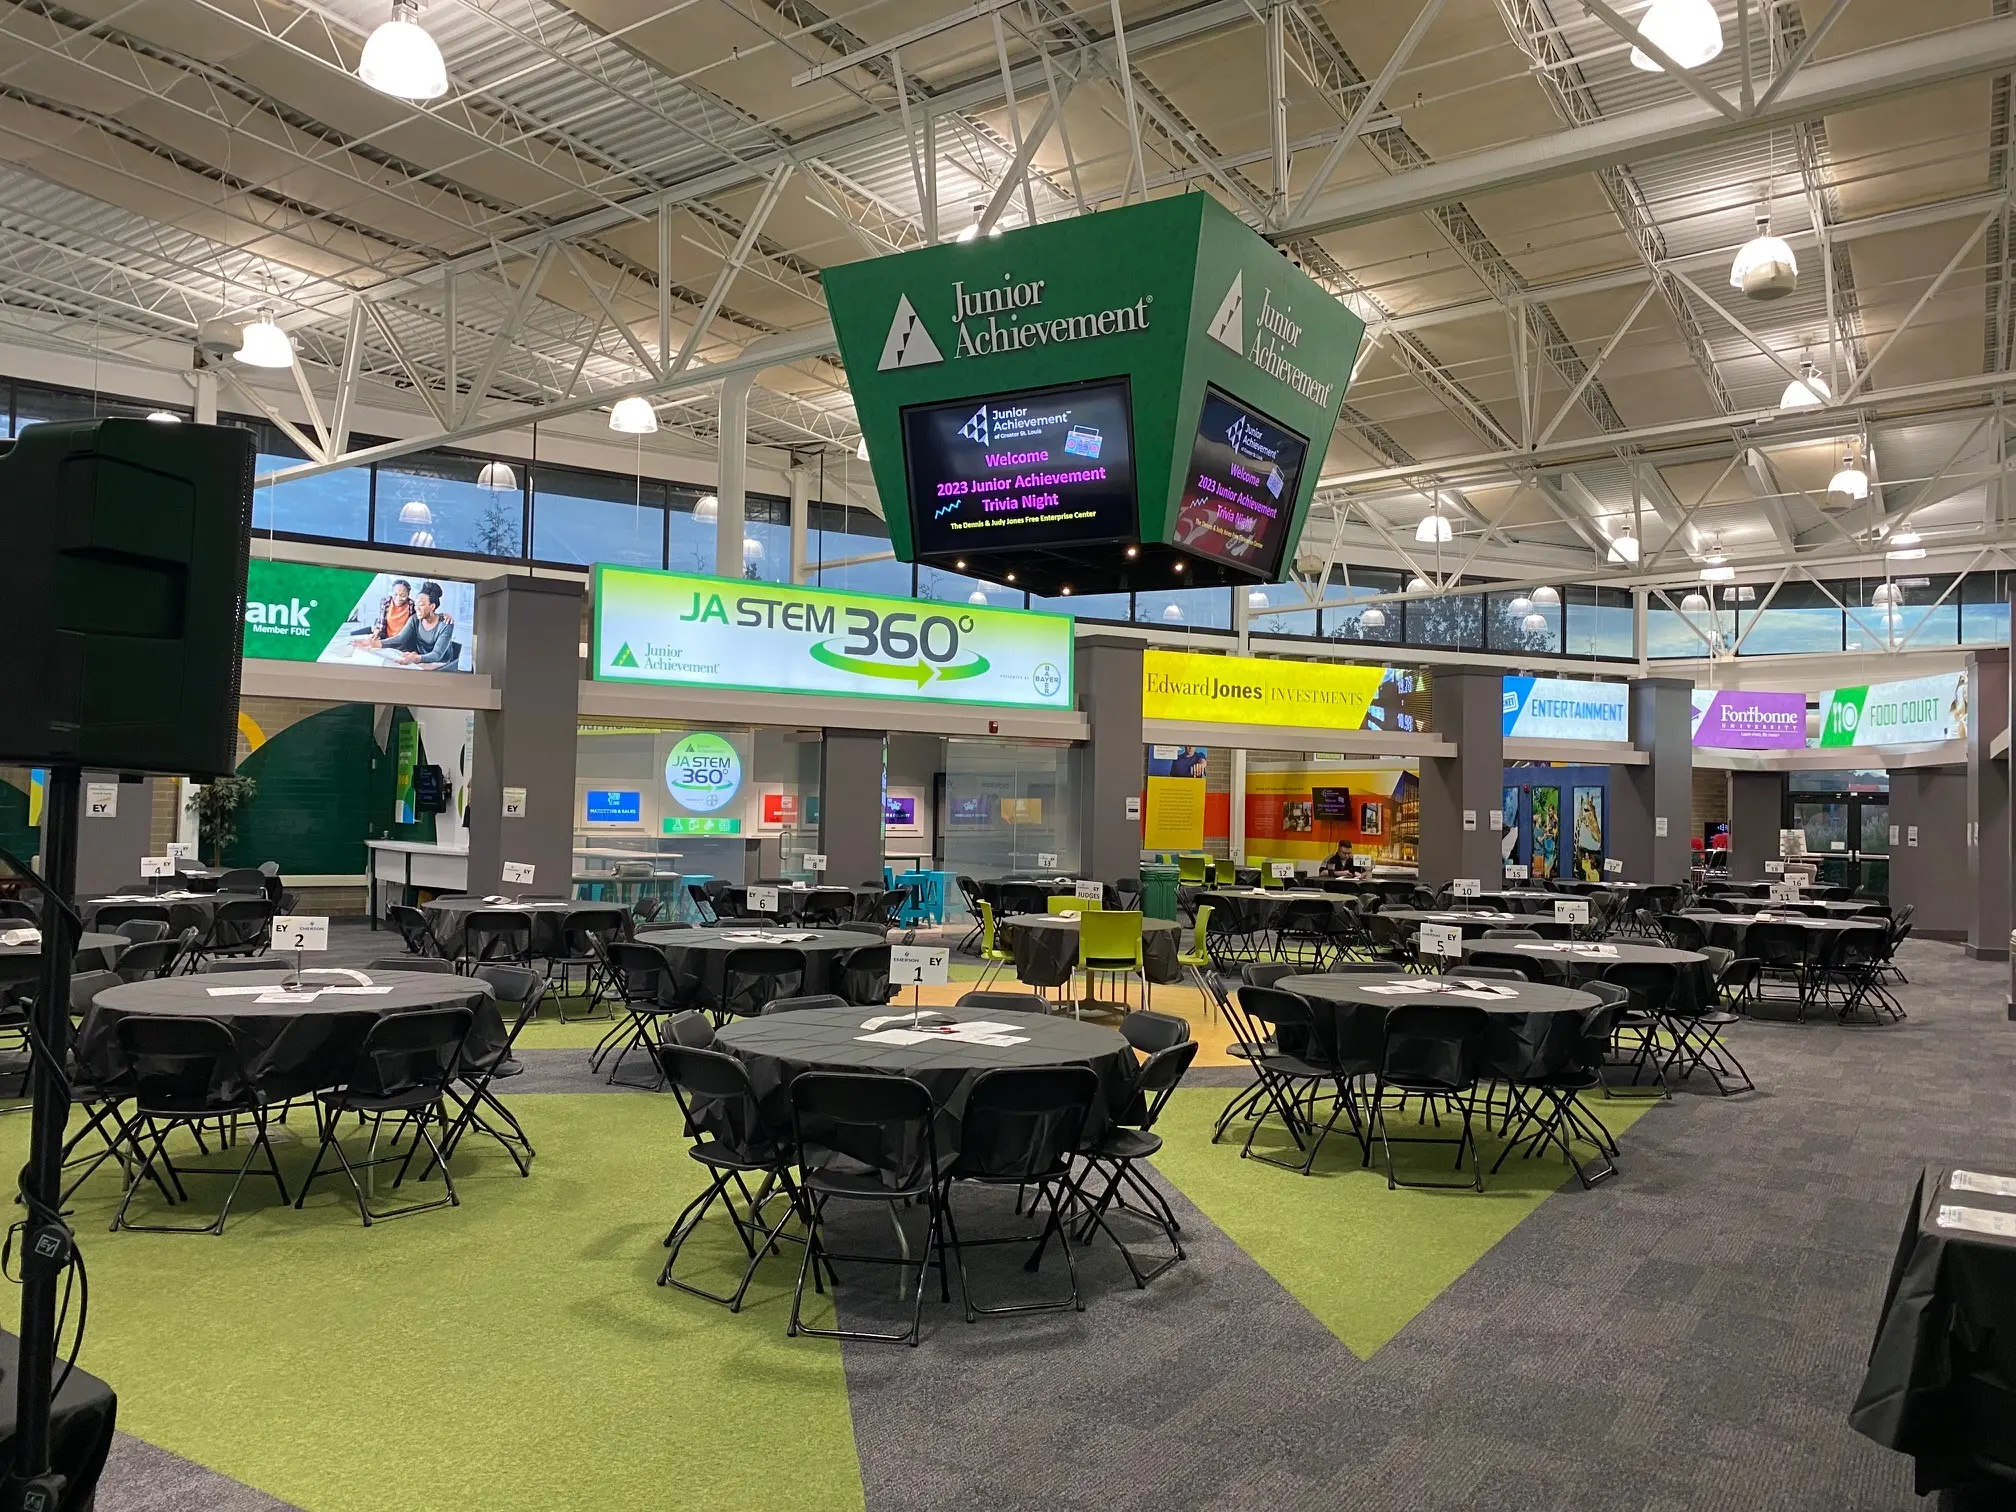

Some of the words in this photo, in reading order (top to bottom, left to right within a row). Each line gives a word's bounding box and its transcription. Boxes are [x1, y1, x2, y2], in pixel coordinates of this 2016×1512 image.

[952, 273, 1045, 323] Junior
[1256, 287, 1302, 348] Junior
[953, 296, 1150, 359] Achievement
[1247, 329, 1331, 409] Achievement
[992, 407, 1028, 420] Junior
[993, 413, 1068, 432] Achievement
[1245, 423, 1263, 440] Junior
[985, 450, 1049, 467] Welcome
[936, 480, 969, 497] 2023
[970, 477, 1012, 493] Junior
[1014, 466, 1106, 488] Achievement
[1230, 462, 1260, 487] Welcome
[982, 497, 1018, 512] Trivia
[1021, 493, 1059, 510] Night
[1198, 474, 1217, 493] 2023
[1216, 482, 1238, 501] Junior
[1237, 492, 1277, 519] Achievement
[950, 522, 963, 530] The
[963, 519, 984, 529] Dennis
[991, 518, 1006, 527] Judy
[1006, 517, 1025, 525] Jones
[1025, 515, 1039, 523] Free
[1040, 512, 1074, 522] Enterprise
[1074, 510, 1097, 519] Center
[1216, 504, 1235, 523] Trivia
[1234, 512, 1253, 530] Night
[245, 597, 311, 628] ank
[679, 592, 730, 625] JA
[736, 597, 835, 635] STEM
[252, 624, 289, 635] Member
[290, 627, 311, 637] FDIC
[644, 642, 683, 658] Junior
[644, 656, 720, 674] Achievement
[1035, 675, 1059, 684] BAYER
[1146, 672, 1210, 696] Edward
[1211, 677, 1263, 699] Jones
[1270, 687, 1364, 706] INVESTMENTS
[1531, 698, 1624, 722] ENTERTAINMENT
[1720, 704, 1798, 724] Fontbonne
[1870, 703, 1898, 727] FOOD
[1901, 697, 1939, 724] COURT
[1721, 723, 1797, 731] UNIVERSITY
[672, 755, 690, 767] JA
[692, 756, 731, 769] STEM
[92, 804, 107, 813] EY
[507, 804, 519, 813] EY
[154, 867, 161, 875] 4
[812, 861, 818, 869] 8
[515, 873, 521, 881] 7
[1077, 891, 1100, 900] JUDGES
[1462, 888, 1472, 896] 10
[1779, 893, 1790, 901] 11
[759, 898, 766, 909] 6
[1568, 912, 1575, 923] 9
[275, 924, 289, 933] EY
[294, 933, 304, 948] 2
[1447, 933, 1457, 941] EY
[1436, 940, 1444, 952] 5
[929, 957, 943, 966] EY
[913, 966, 923, 982] 1
